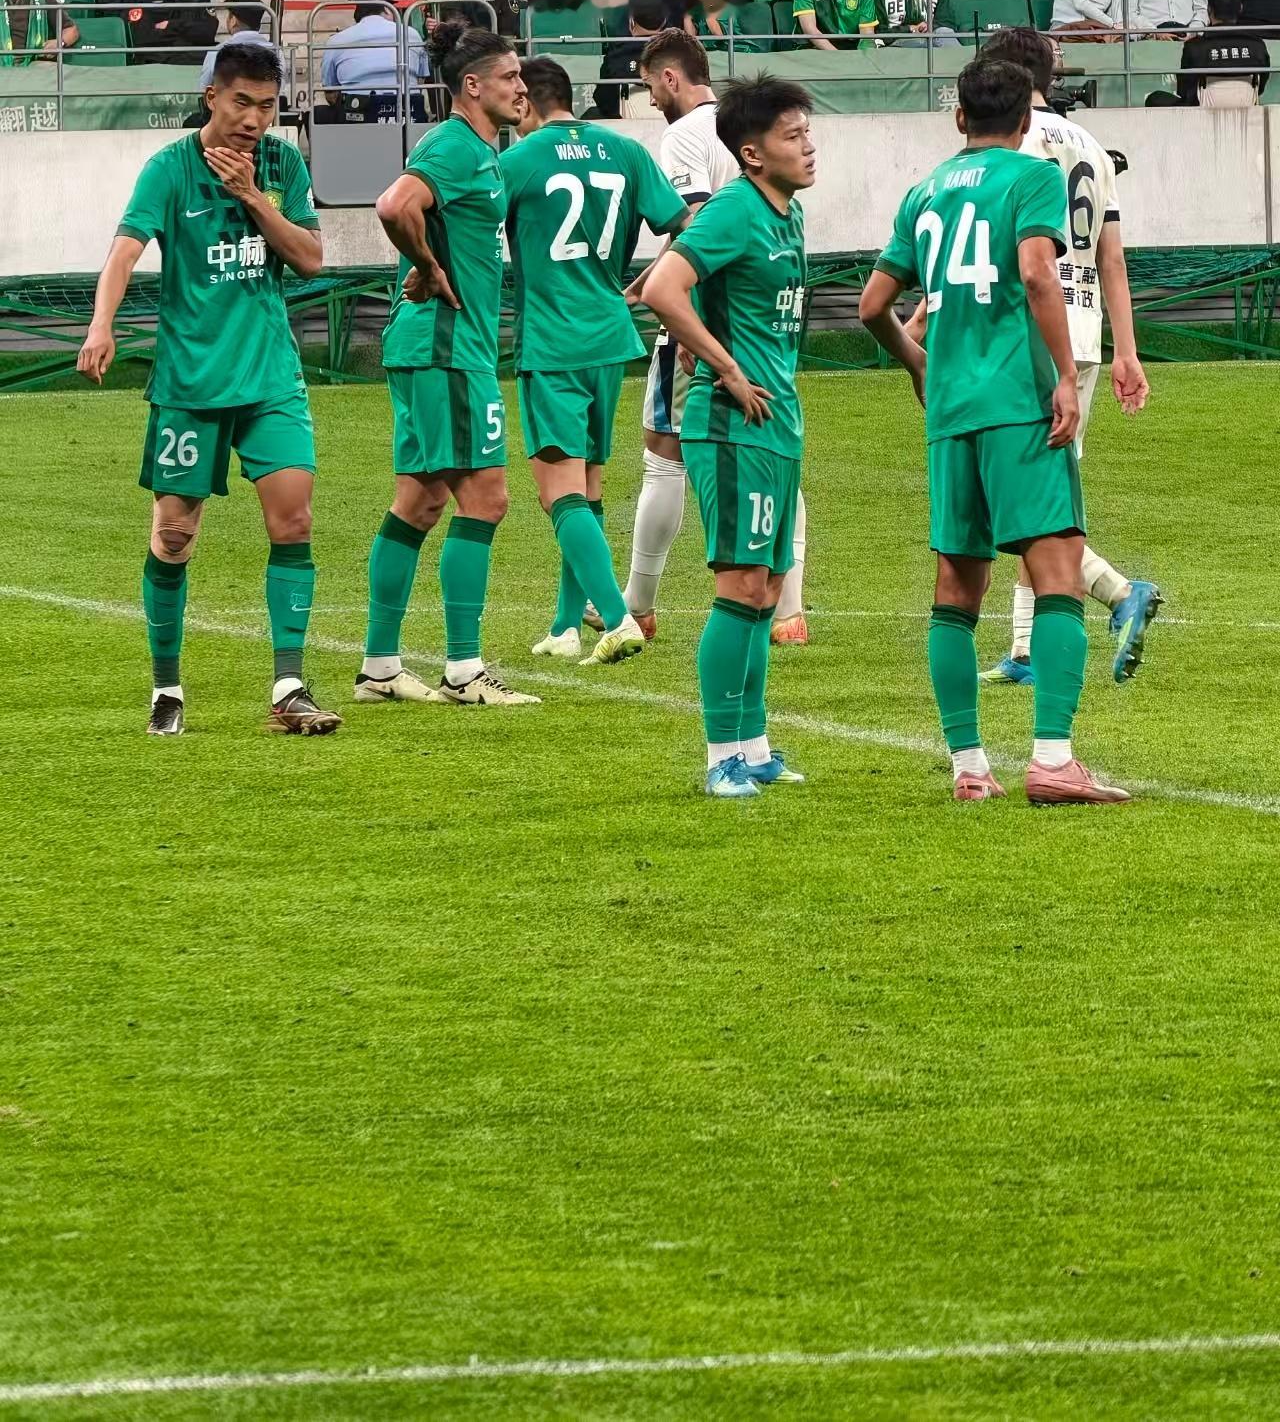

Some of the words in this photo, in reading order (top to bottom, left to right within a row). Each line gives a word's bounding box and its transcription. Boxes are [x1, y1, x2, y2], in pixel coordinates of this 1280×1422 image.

[554, 143, 592, 160] WANG
[597, 143, 611, 160] G.
[1040, 127, 1064, 145] ZHU
[943, 167, 986, 189] HAMIT
[545, 170, 626, 262] 27
[207, 234, 267, 272] 中赫
[915, 201, 999, 314] 24
[486, 402, 502, 441] 5
[157, 427, 199, 467] 26
[748, 492, 774, 537] 18
